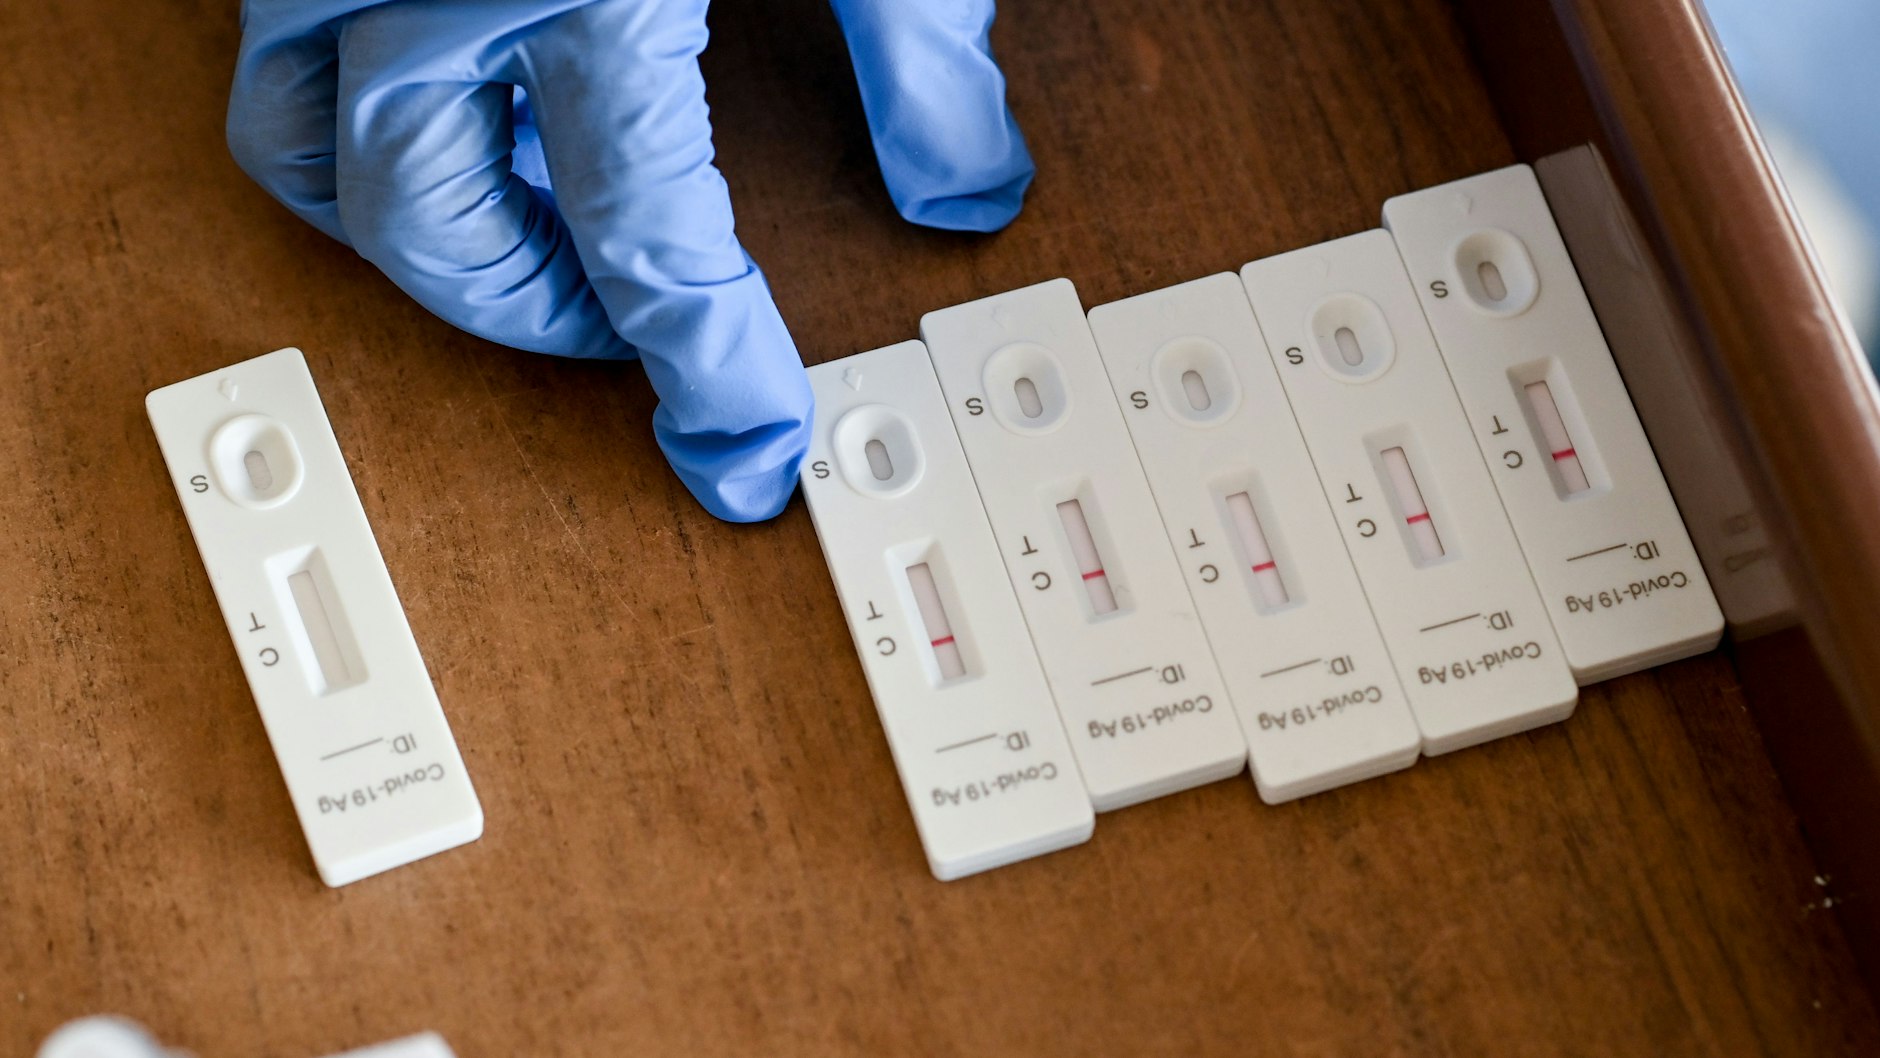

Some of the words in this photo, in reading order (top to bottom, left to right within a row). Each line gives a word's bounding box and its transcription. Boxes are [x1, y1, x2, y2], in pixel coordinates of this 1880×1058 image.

[1429, 279, 1450, 300] S
[1284, 345, 1305, 366] S
[964, 396, 985, 417] S
[1129, 390, 1150, 411] S
[1491, 414, 1510, 436] T
[810, 460, 831, 480] S
[1502, 449, 1524, 470] C
[189, 474, 210, 494] S
[1345, 482, 1364, 504] T
[1188, 527, 1206, 550] T
[1356, 517, 1378, 539] C
[1020, 535, 1040, 557] T
[1030, 570, 1053, 592] C
[1198, 563, 1220, 585] C
[1597, 570, 1692, 609] Covid-19
[865, 600, 885, 622] T
[1564, 594, 1595, 614] Ag
[248, 611, 267, 634] T
[258, 646, 281, 668] C
[875, 635, 898, 658] C
[1450, 640, 1543, 680] Covid-19
[1416, 665, 1448, 685] Ag
[1120, 694, 1214, 734] Covid-19
[1289, 685, 1383, 726] Covid-19
[1086, 719, 1118, 740] Ag
[1256, 711, 1288, 731] Ag
[351, 762, 446, 808] Covid-19
[964, 761, 1058, 802] Covid-19
[316, 793, 348, 815] Ag
[930, 787, 961, 807] Ag
